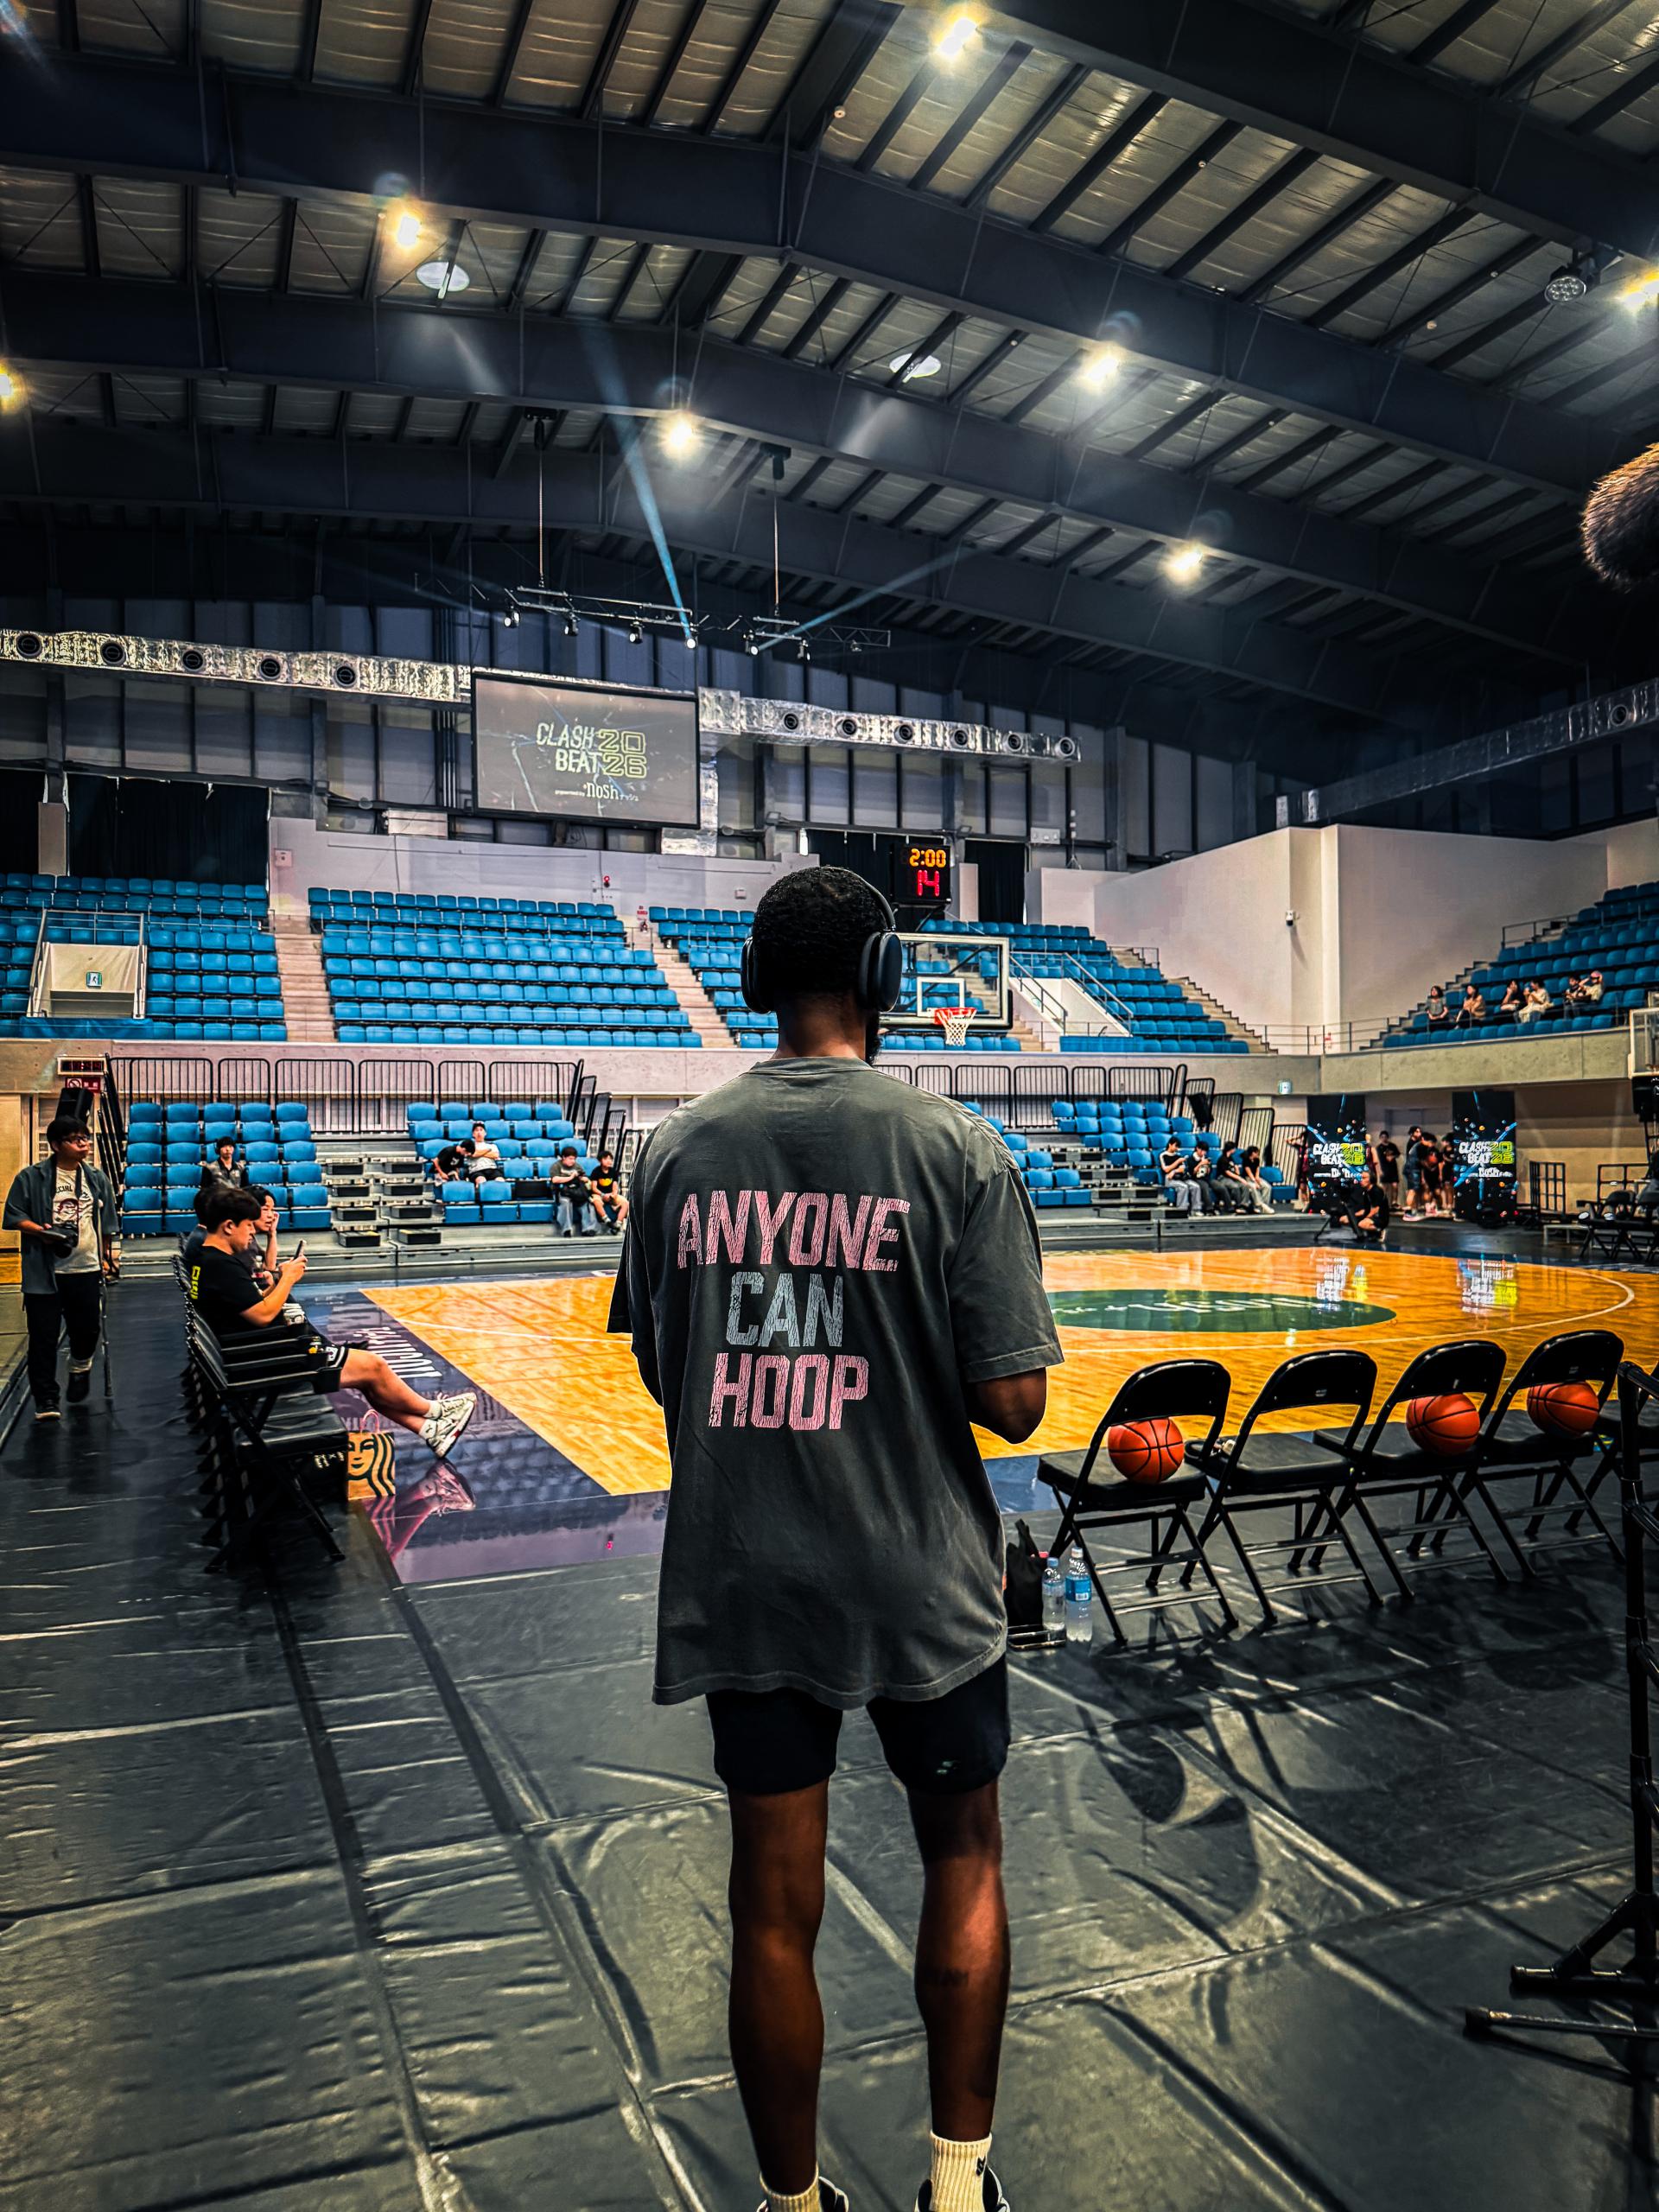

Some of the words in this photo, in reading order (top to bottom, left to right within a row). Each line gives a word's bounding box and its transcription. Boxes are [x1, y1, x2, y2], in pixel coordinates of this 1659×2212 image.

[537, 722, 595, 748] CLASH
[597, 728, 646, 754] 20
[555, 748, 602, 773] BEAT
[602, 753, 646, 779] 26
[910, 849, 946, 868] 2:00
[917, 869, 939, 897] 14
[677, 1190, 911, 1272] ANYONE
[726, 1271, 843, 1347] CAN
[709, 1352, 869, 1431] HOOP
